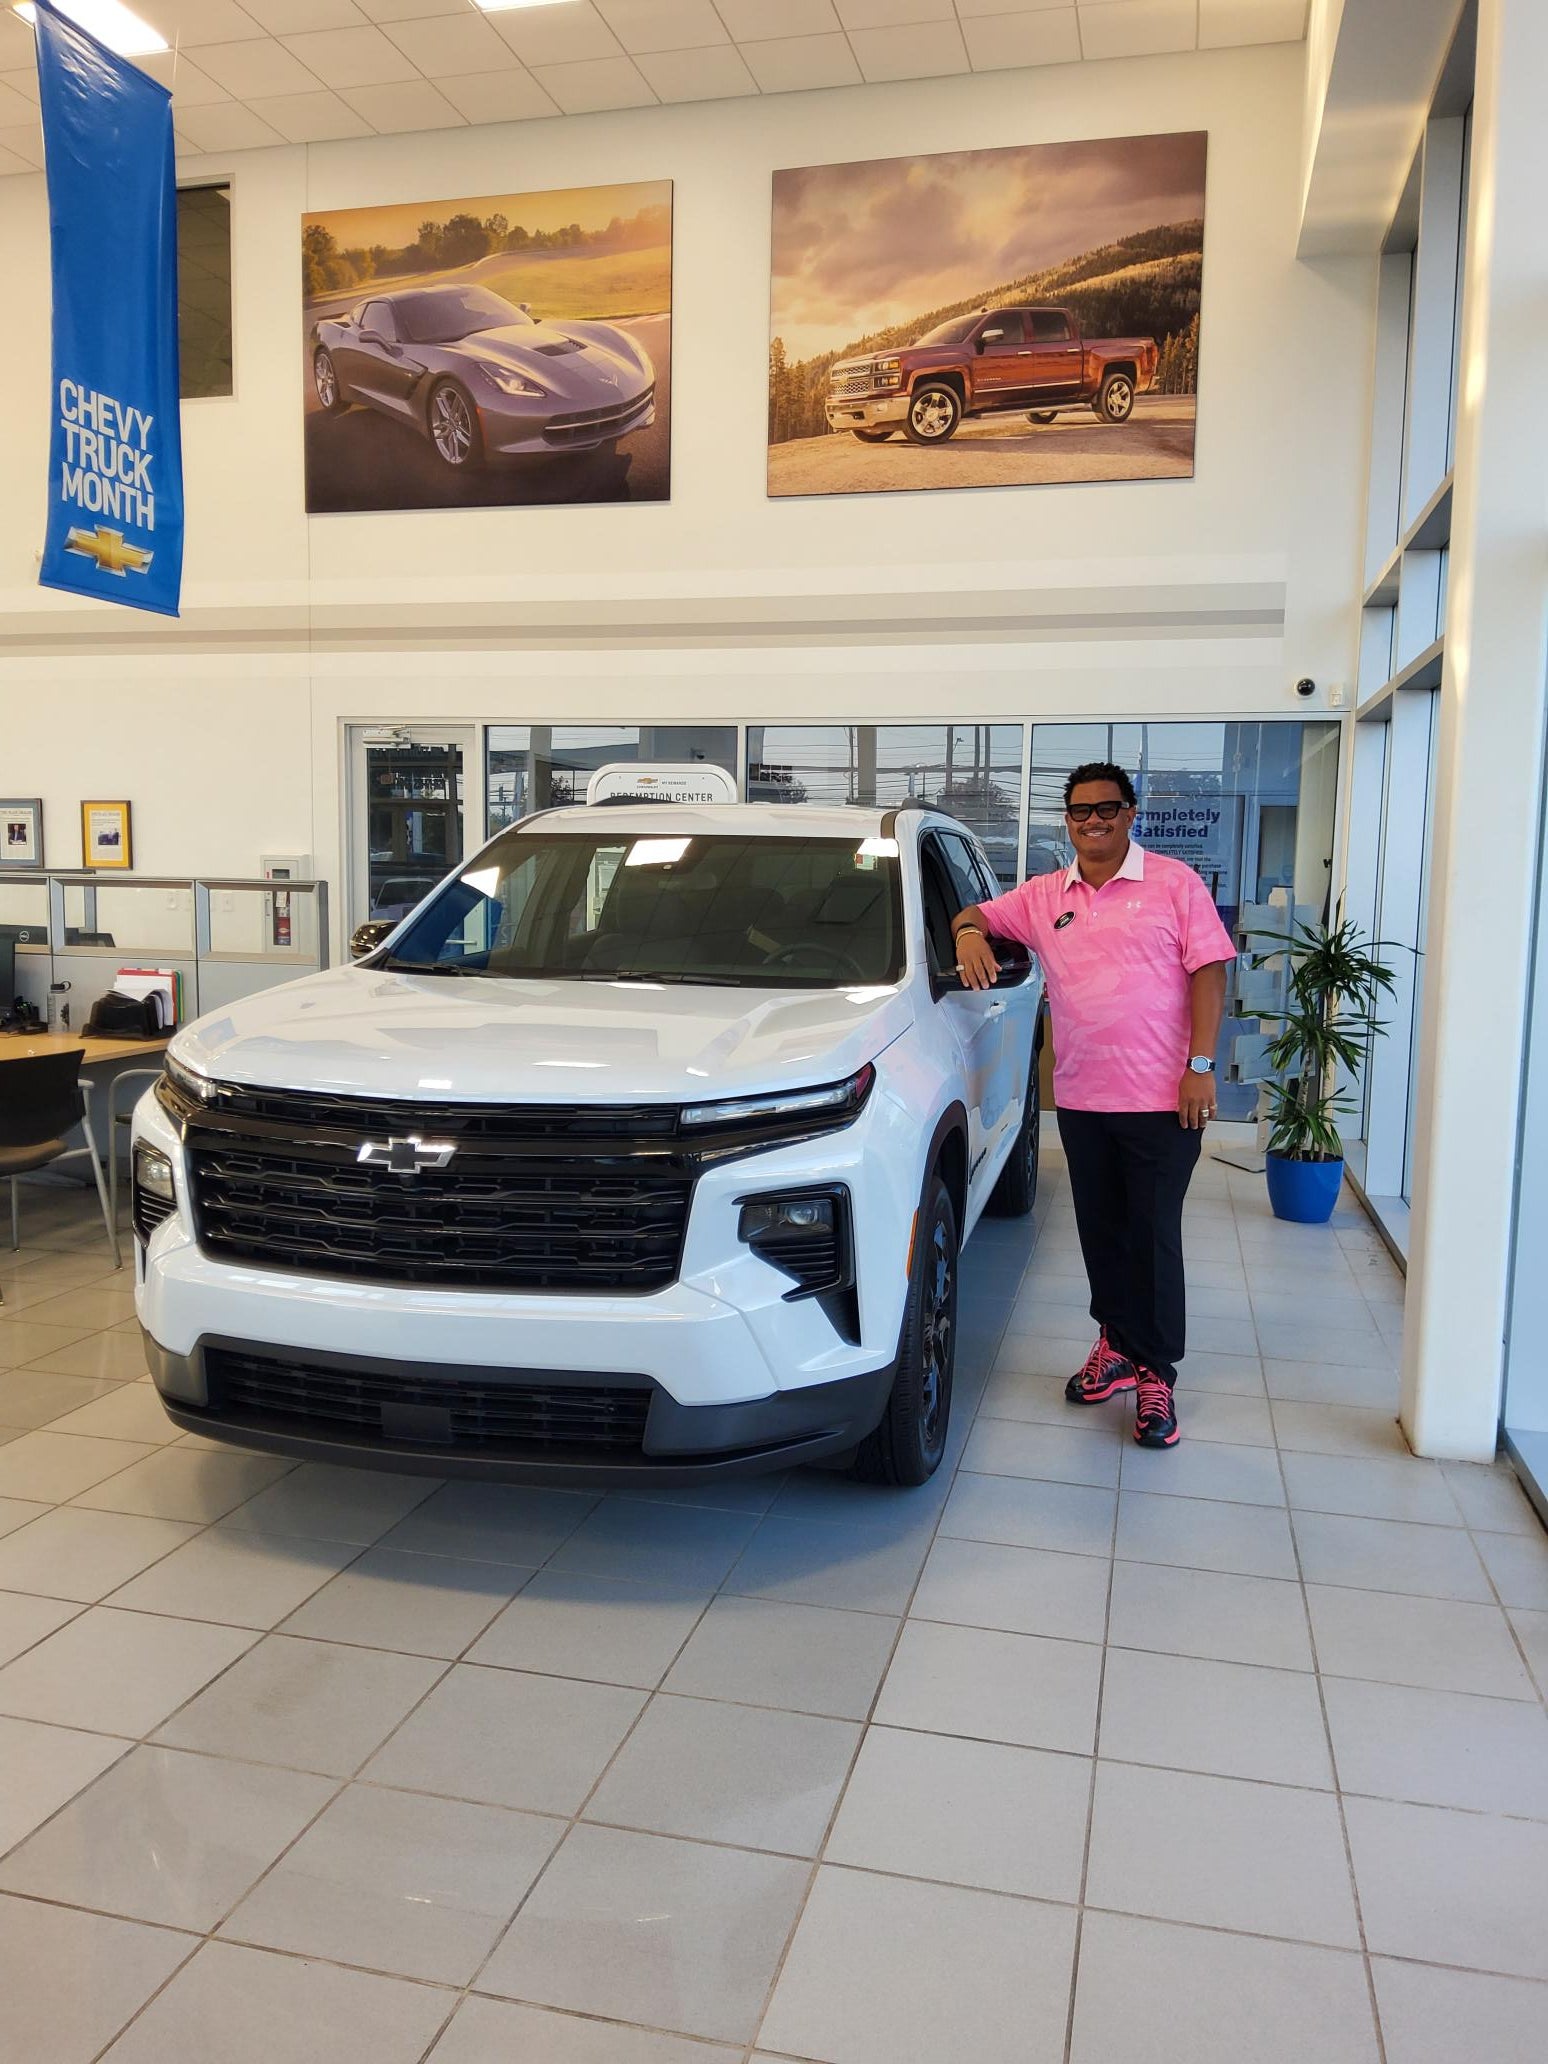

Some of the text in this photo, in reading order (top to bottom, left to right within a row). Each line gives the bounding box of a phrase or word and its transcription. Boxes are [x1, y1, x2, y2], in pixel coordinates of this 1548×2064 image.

[60, 379, 153, 450] CHEVY
[60, 419, 153, 493] TRUCK
[61, 462, 154, 531] MONTH
[675, 792, 713, 802] CENTER
[1137, 808, 1220, 824] ompletely
[1133, 825, 1208, 838] Satisfied
